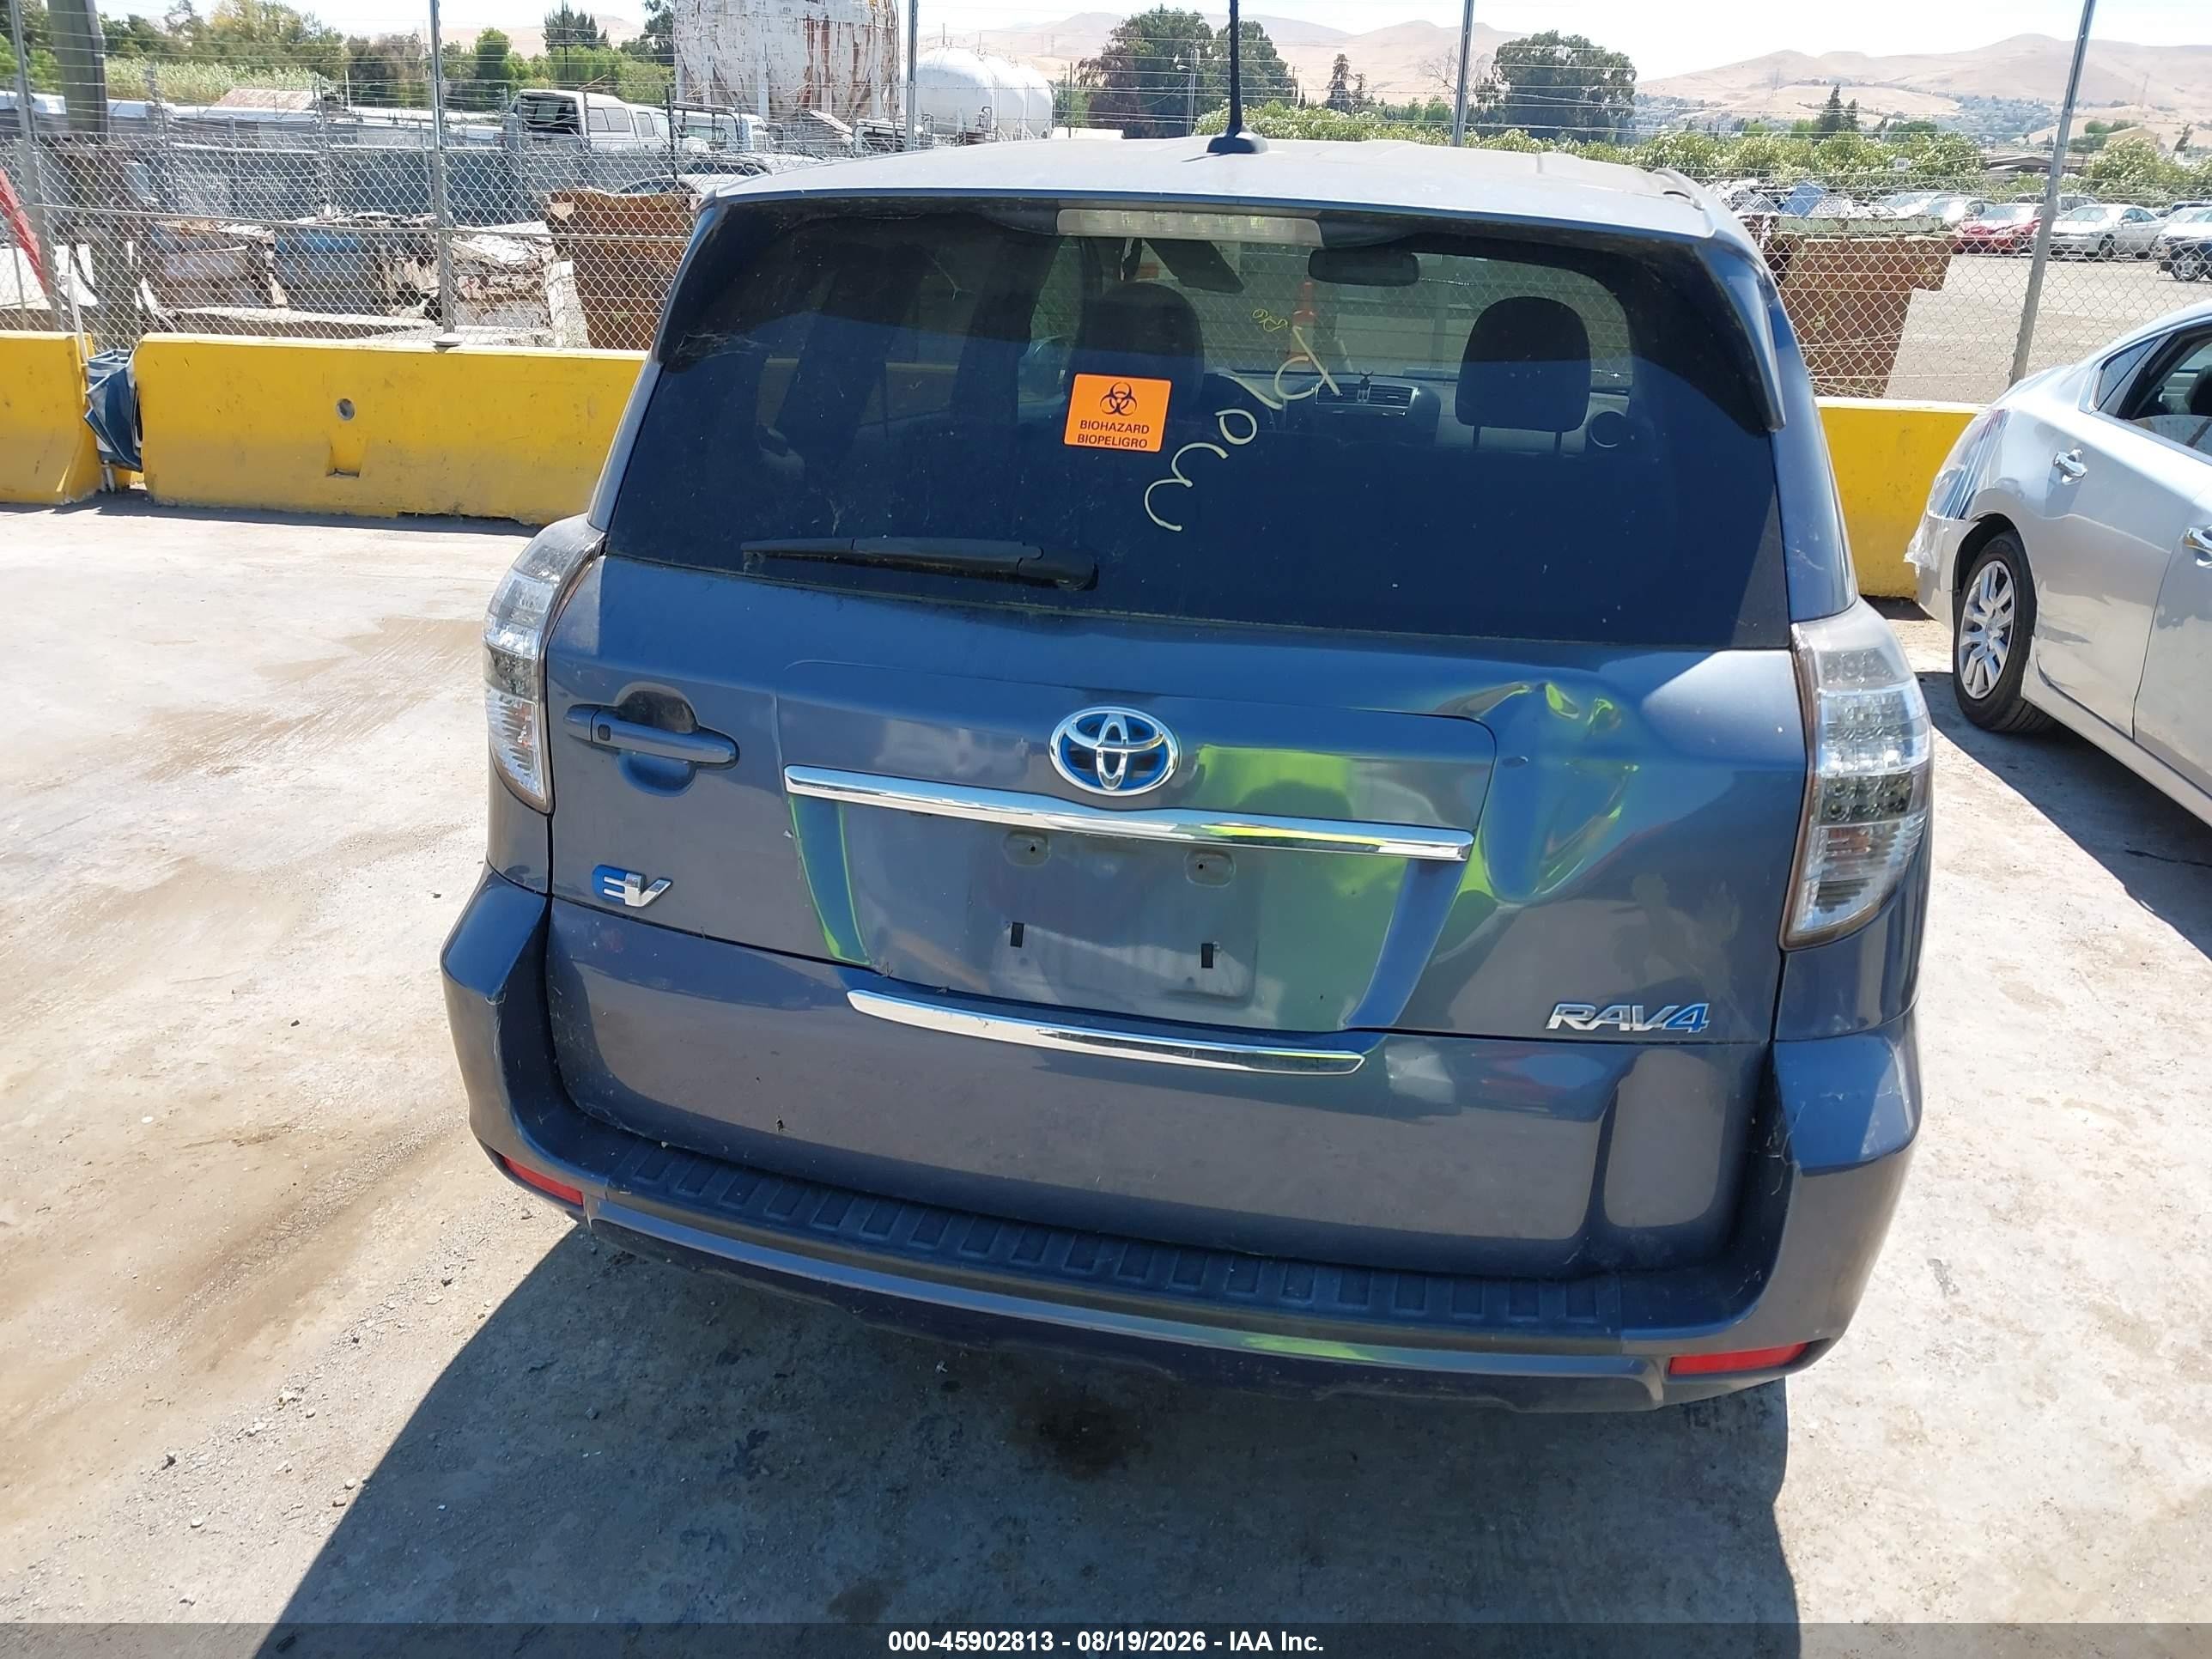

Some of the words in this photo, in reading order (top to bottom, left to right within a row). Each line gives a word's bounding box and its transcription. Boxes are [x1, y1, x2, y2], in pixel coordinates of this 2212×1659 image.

[1079, 419, 1150, 434] BIOHAZARD
[1077, 433, 1148, 448] BIOPELIGRO
[592, 864, 672, 907] EV
[1545, 1002, 1711, 1034] RAV4
